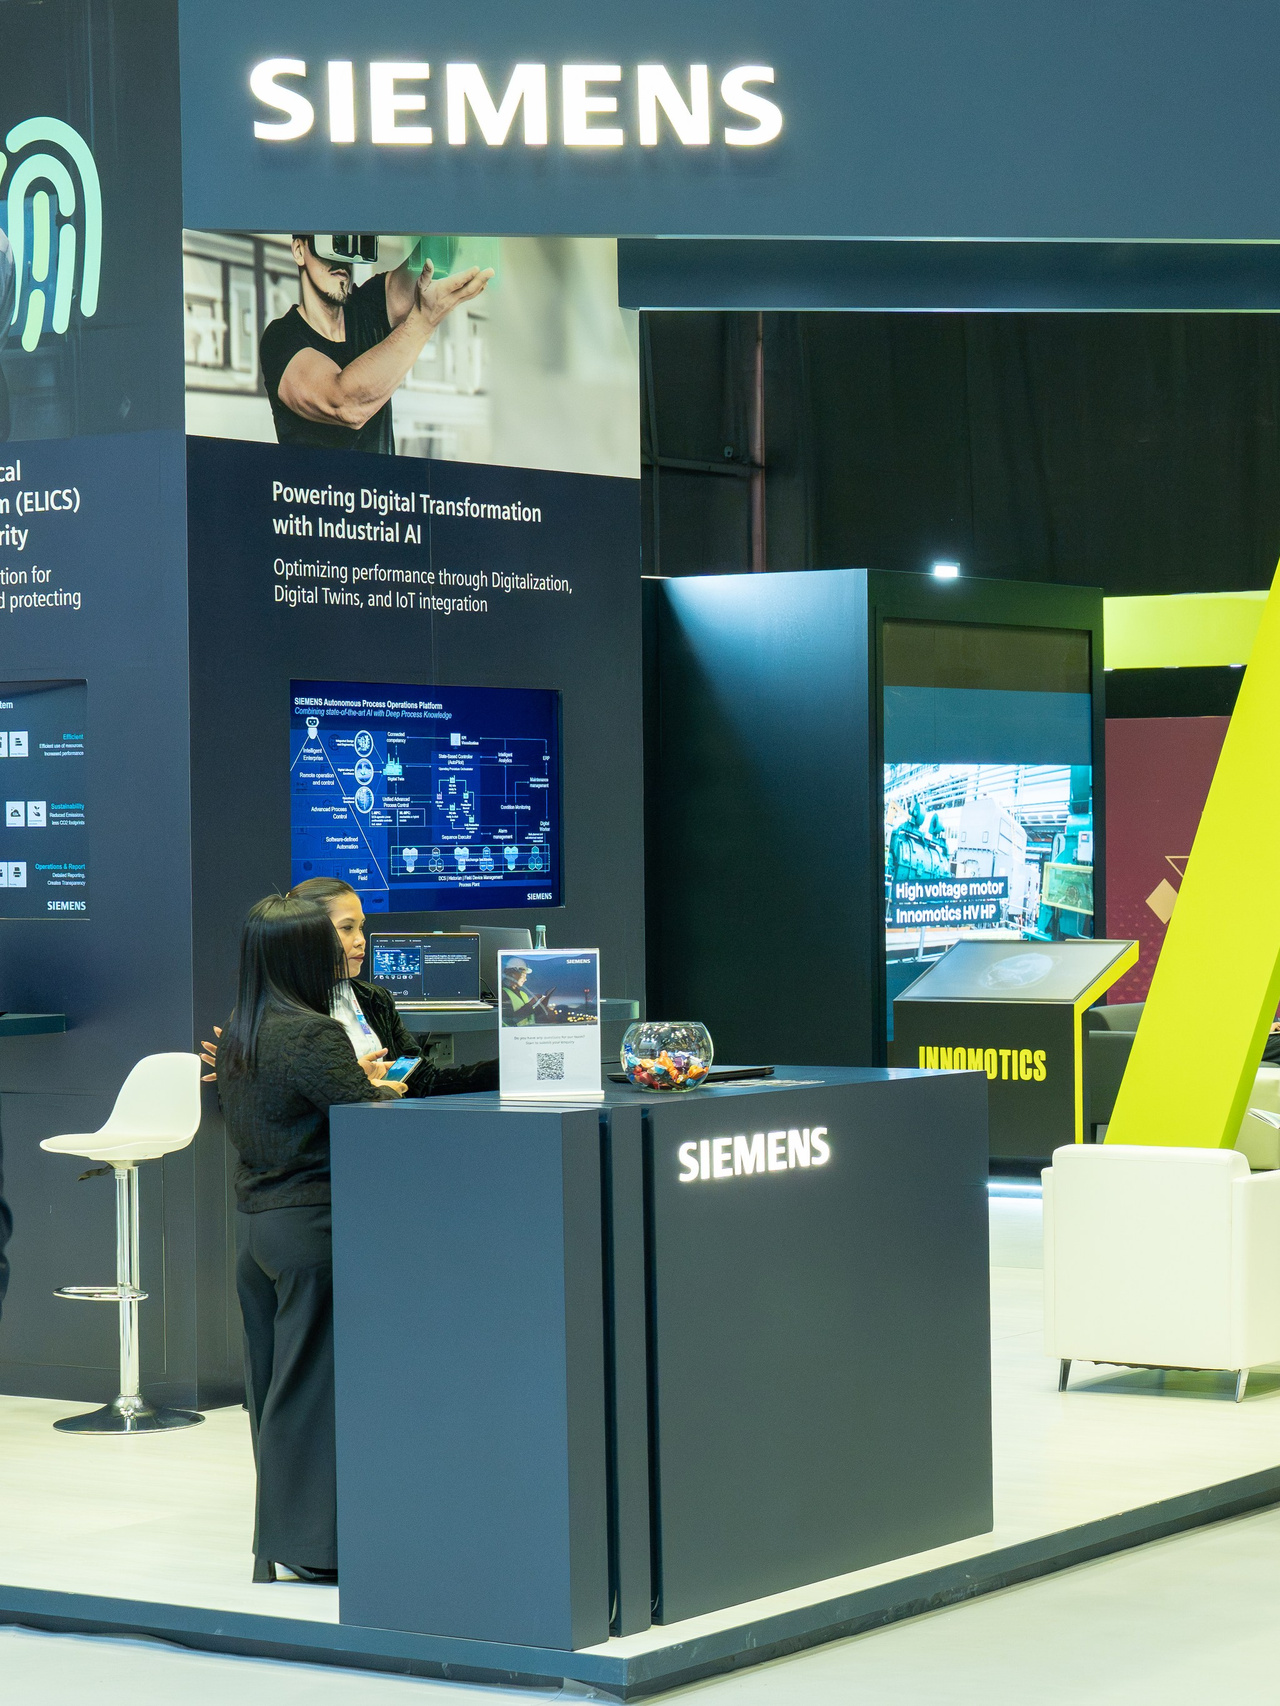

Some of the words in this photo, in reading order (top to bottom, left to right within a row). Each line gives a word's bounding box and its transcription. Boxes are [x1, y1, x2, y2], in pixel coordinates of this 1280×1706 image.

[249, 58, 783, 146] SIEMENS
[16, 487, 80, 516] (ELICS)
[272, 480, 354, 513] Powering
[360, 488, 415, 516] Digital
[420, 494, 542, 522] Transformation
[0, 524, 28, 550] rity
[272, 514, 312, 536] with
[318, 517, 400, 542] Industrial
[404, 524, 422, 544] AI
[0, 567, 27, 584] tion
[31, 566, 52, 584] for
[274, 558, 348, 584] Optimizing
[352, 564, 435, 584] performance
[438, 568, 488, 591] through
[492, 572, 572, 594] Digitalization,
[10, 588, 82, 613] protecting
[274, 585, 318, 607] Digital
[322, 588, 364, 608] Twins,
[368, 590, 392, 608] and
[396, 592, 416, 608] IoT
[420, 592, 488, 615] integration
[294, 697, 322, 706] SIEMENS
[324, 698, 362, 708] Autonomous
[362, 700, 386, 708] Process
[387, 701, 418, 710] Operations
[419, 702, 442, 710] Platform
[294, 706, 324, 716] Combining
[326, 708, 366, 716] state-of-the-art
[386, 710, 400, 718] Deep
[401, 710, 422, 718] Process
[424, 711, 452, 720] Knowledge
[896, 882, 923, 901] High
[925, 881, 968, 900] voltage
[970, 881, 1004, 895] motor
[47, 901, 86, 911] SIEMENS
[896, 907, 961, 924] Innomotics
[964, 906, 979, 920] HV
[981, 904, 996, 919] HP
[918, 1046, 1046, 1082] INNOMOTICS
[678, 1127, 830, 1182] SIEMENS
